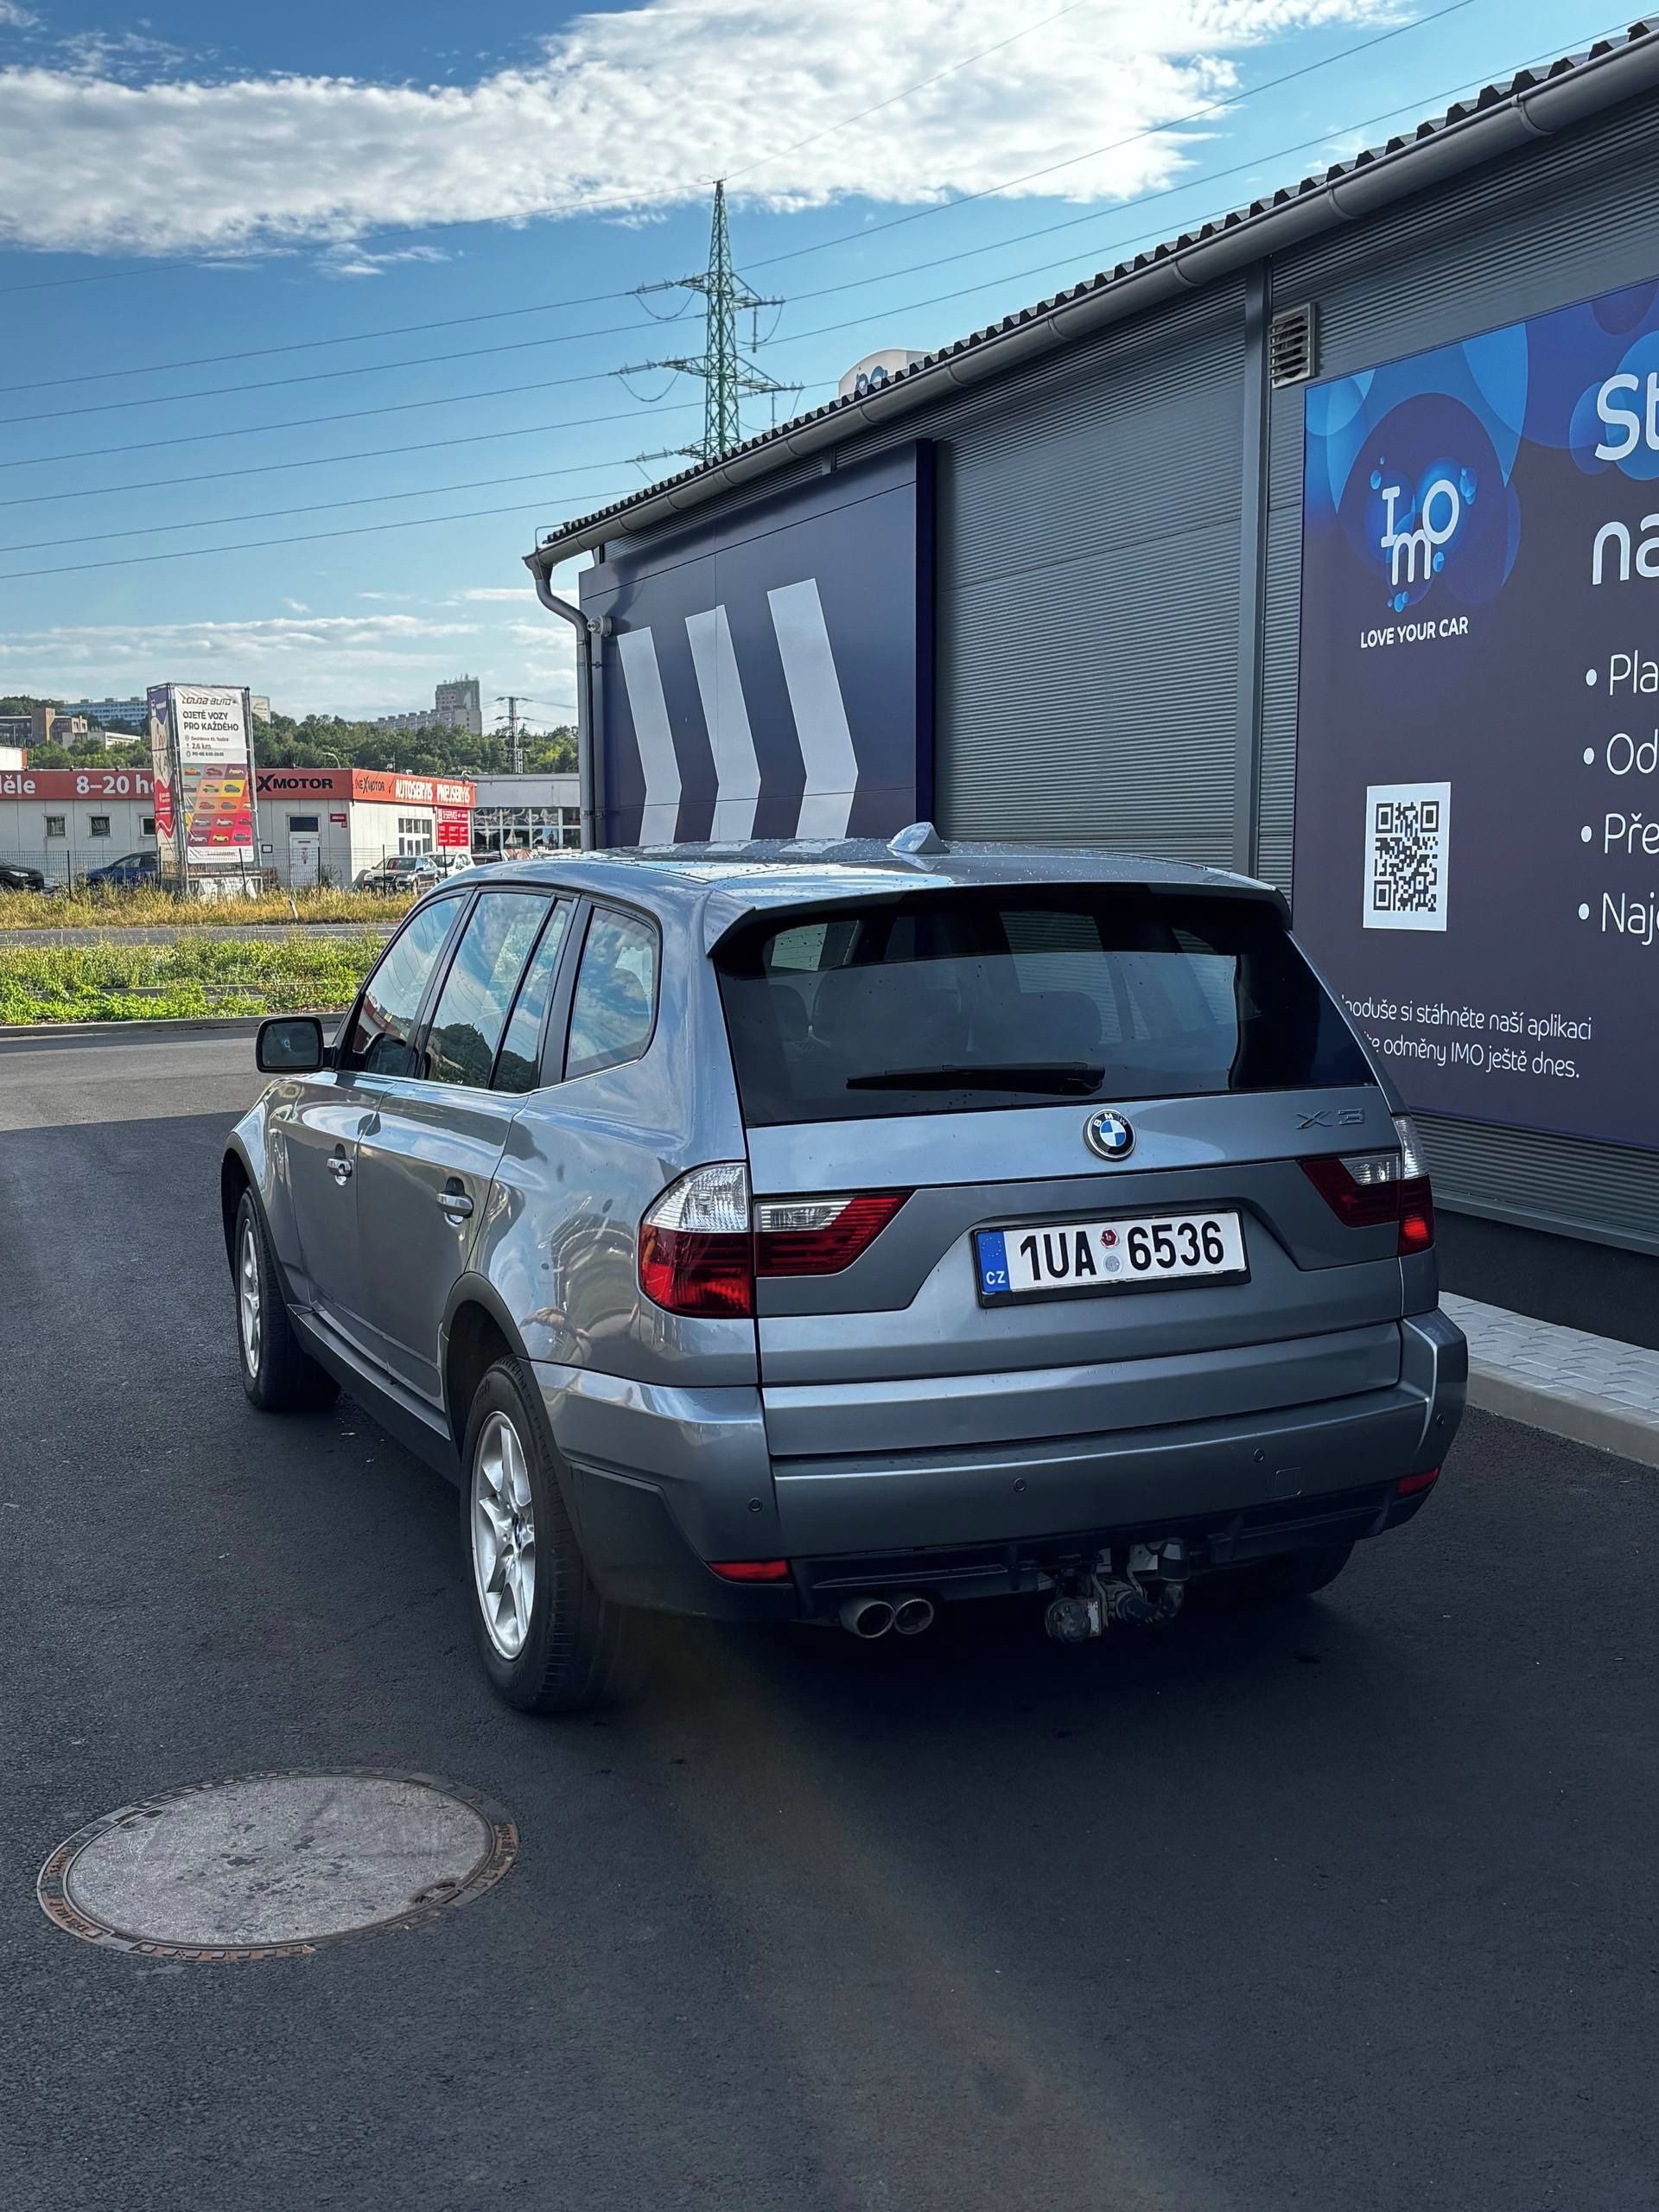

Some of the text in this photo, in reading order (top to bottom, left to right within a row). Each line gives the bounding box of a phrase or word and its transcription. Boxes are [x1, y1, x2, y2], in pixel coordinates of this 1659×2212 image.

[1360, 616, 1468, 649] LOVE YOUR CAR
[1610, 650, 1659, 696] Pla
[182, 709, 228, 720] OJETÉ VOZY
[183, 721, 239, 731] PRO KAŽDÉHO
[0, 774, 35, 794] ěle
[136, 774, 153, 794] h
[396, 779, 433, 802] AUTOSERVIS
[1604, 813, 1659, 855] Pře
[1601, 891, 1659, 945] Naj
[1401, 1000, 1413, 1021] si
[1417, 1003, 1484, 1029] stáhněte
[1490, 1011, 1523, 1033] naší
[1528, 1014, 1592, 1041] aplikaci
[1383, 1034, 1446, 1066] odměny
[1451, 1042, 1484, 1066] IMO
[1486, 1045, 1527, 1072] ještě
[1532, 1051, 1580, 1078] dnes.
[1093, 1112, 1127, 1127] BMW
[1296, 1108, 1365, 1129] X3
[985, 1220, 1224, 1285] CZ 1UA 6536
